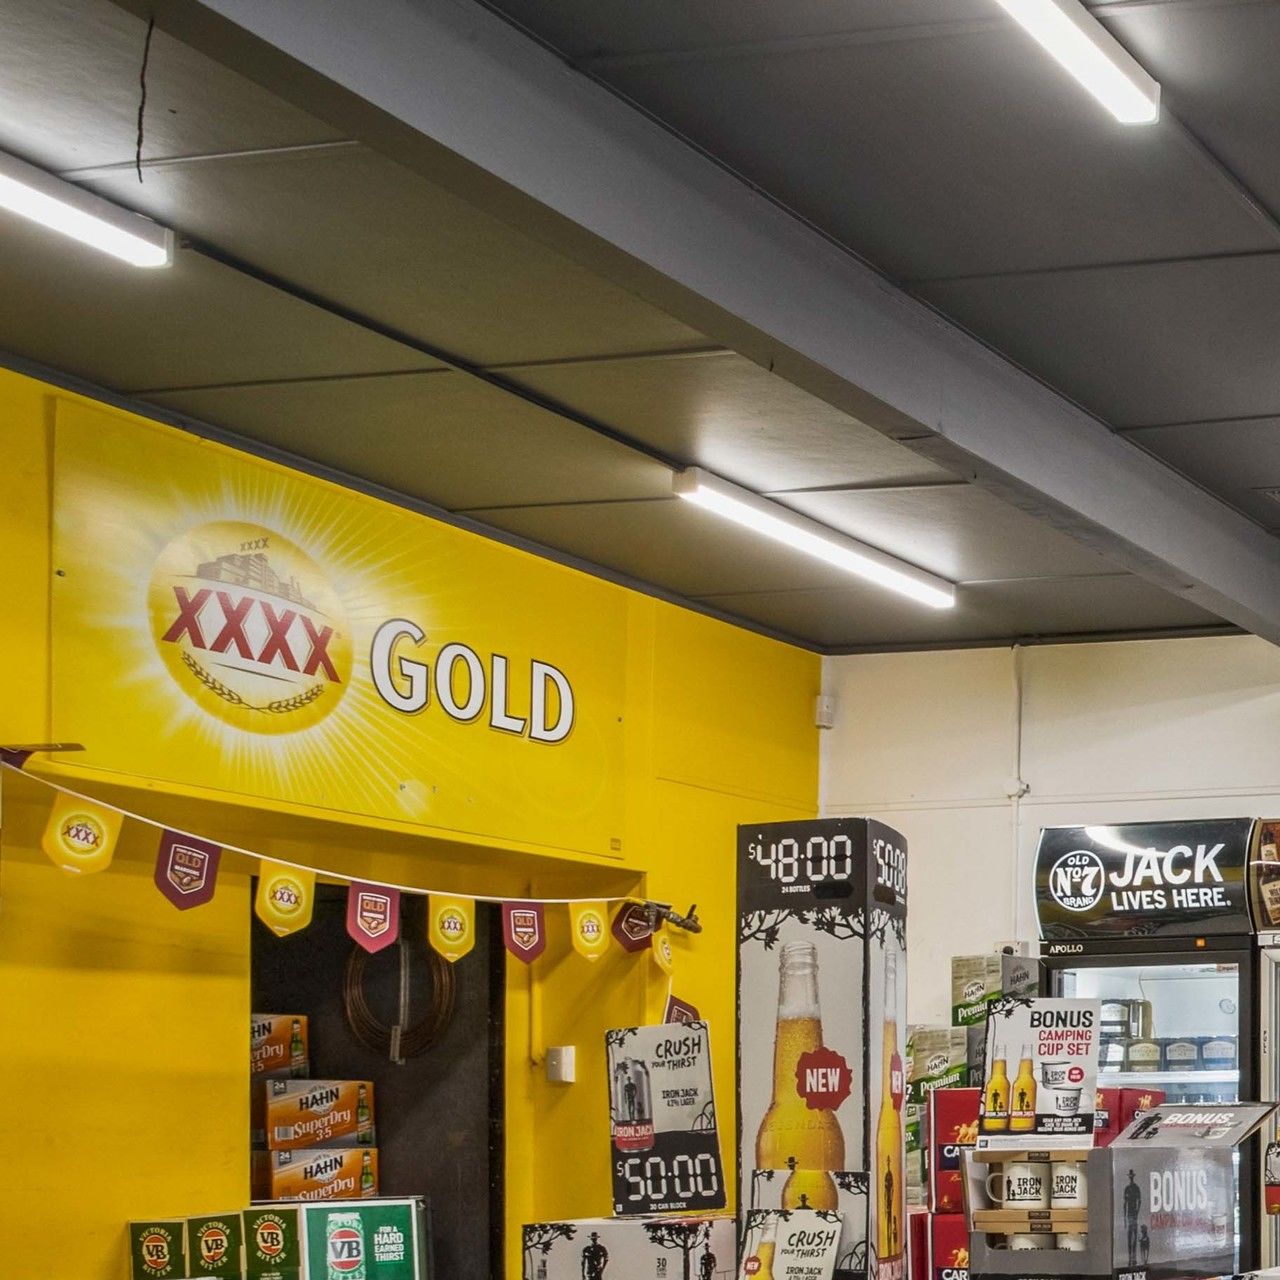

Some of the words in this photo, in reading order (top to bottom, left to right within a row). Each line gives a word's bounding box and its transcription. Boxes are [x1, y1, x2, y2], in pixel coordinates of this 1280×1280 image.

[162, 584, 341, 683] XXXX
[370, 619, 574, 744] GOLD
[63, 824, 99, 847] XXXX
[176, 853, 201, 868] QLD
[749, 835, 851, 882] $48.00
[1068, 856, 1089, 865] OLD
[1109, 843, 1225, 887] JACK
[790, 885, 810, 893] BOTTLES
[363, 900, 384, 912] QLD
[1063, 896, 1094, 907] BRAND
[1111, 890, 1167, 910] LIVES
[1172, 888, 1231, 908] HERE.
[1050, 945, 1083, 953] APOLLO
[1030, 1010, 1093, 1027] BONUS
[1039, 1030, 1092, 1041] CAMPING
[656, 1035, 701, 1060] CRUSH
[1038, 1044, 1063, 1056] CUP
[1068, 1043, 1091, 1055] SET
[652, 1059, 666, 1068] YOUR
[667, 1056, 697, 1071] THIRST
[806, 1068, 840, 1092] NEW
[920, 1074, 960, 1096] Premium
[299, 1087, 340, 1111] HAHN
[293, 1108, 351, 1138] SuperDry
[1162, 1113, 1234, 1124] BONUS
[1017, 1178, 1041, 1186] IRON
[1016, 1186, 1041, 1196] JACK
[1150, 1171, 1208, 1212] BONUS
[253, 1214, 287, 1230] VICTORIA
[260, 1230, 281, 1248] VB
[374, 1232, 403, 1245] HARD
[374, 1244, 404, 1253] EARNED
[374, 1251, 404, 1262] THIRST
